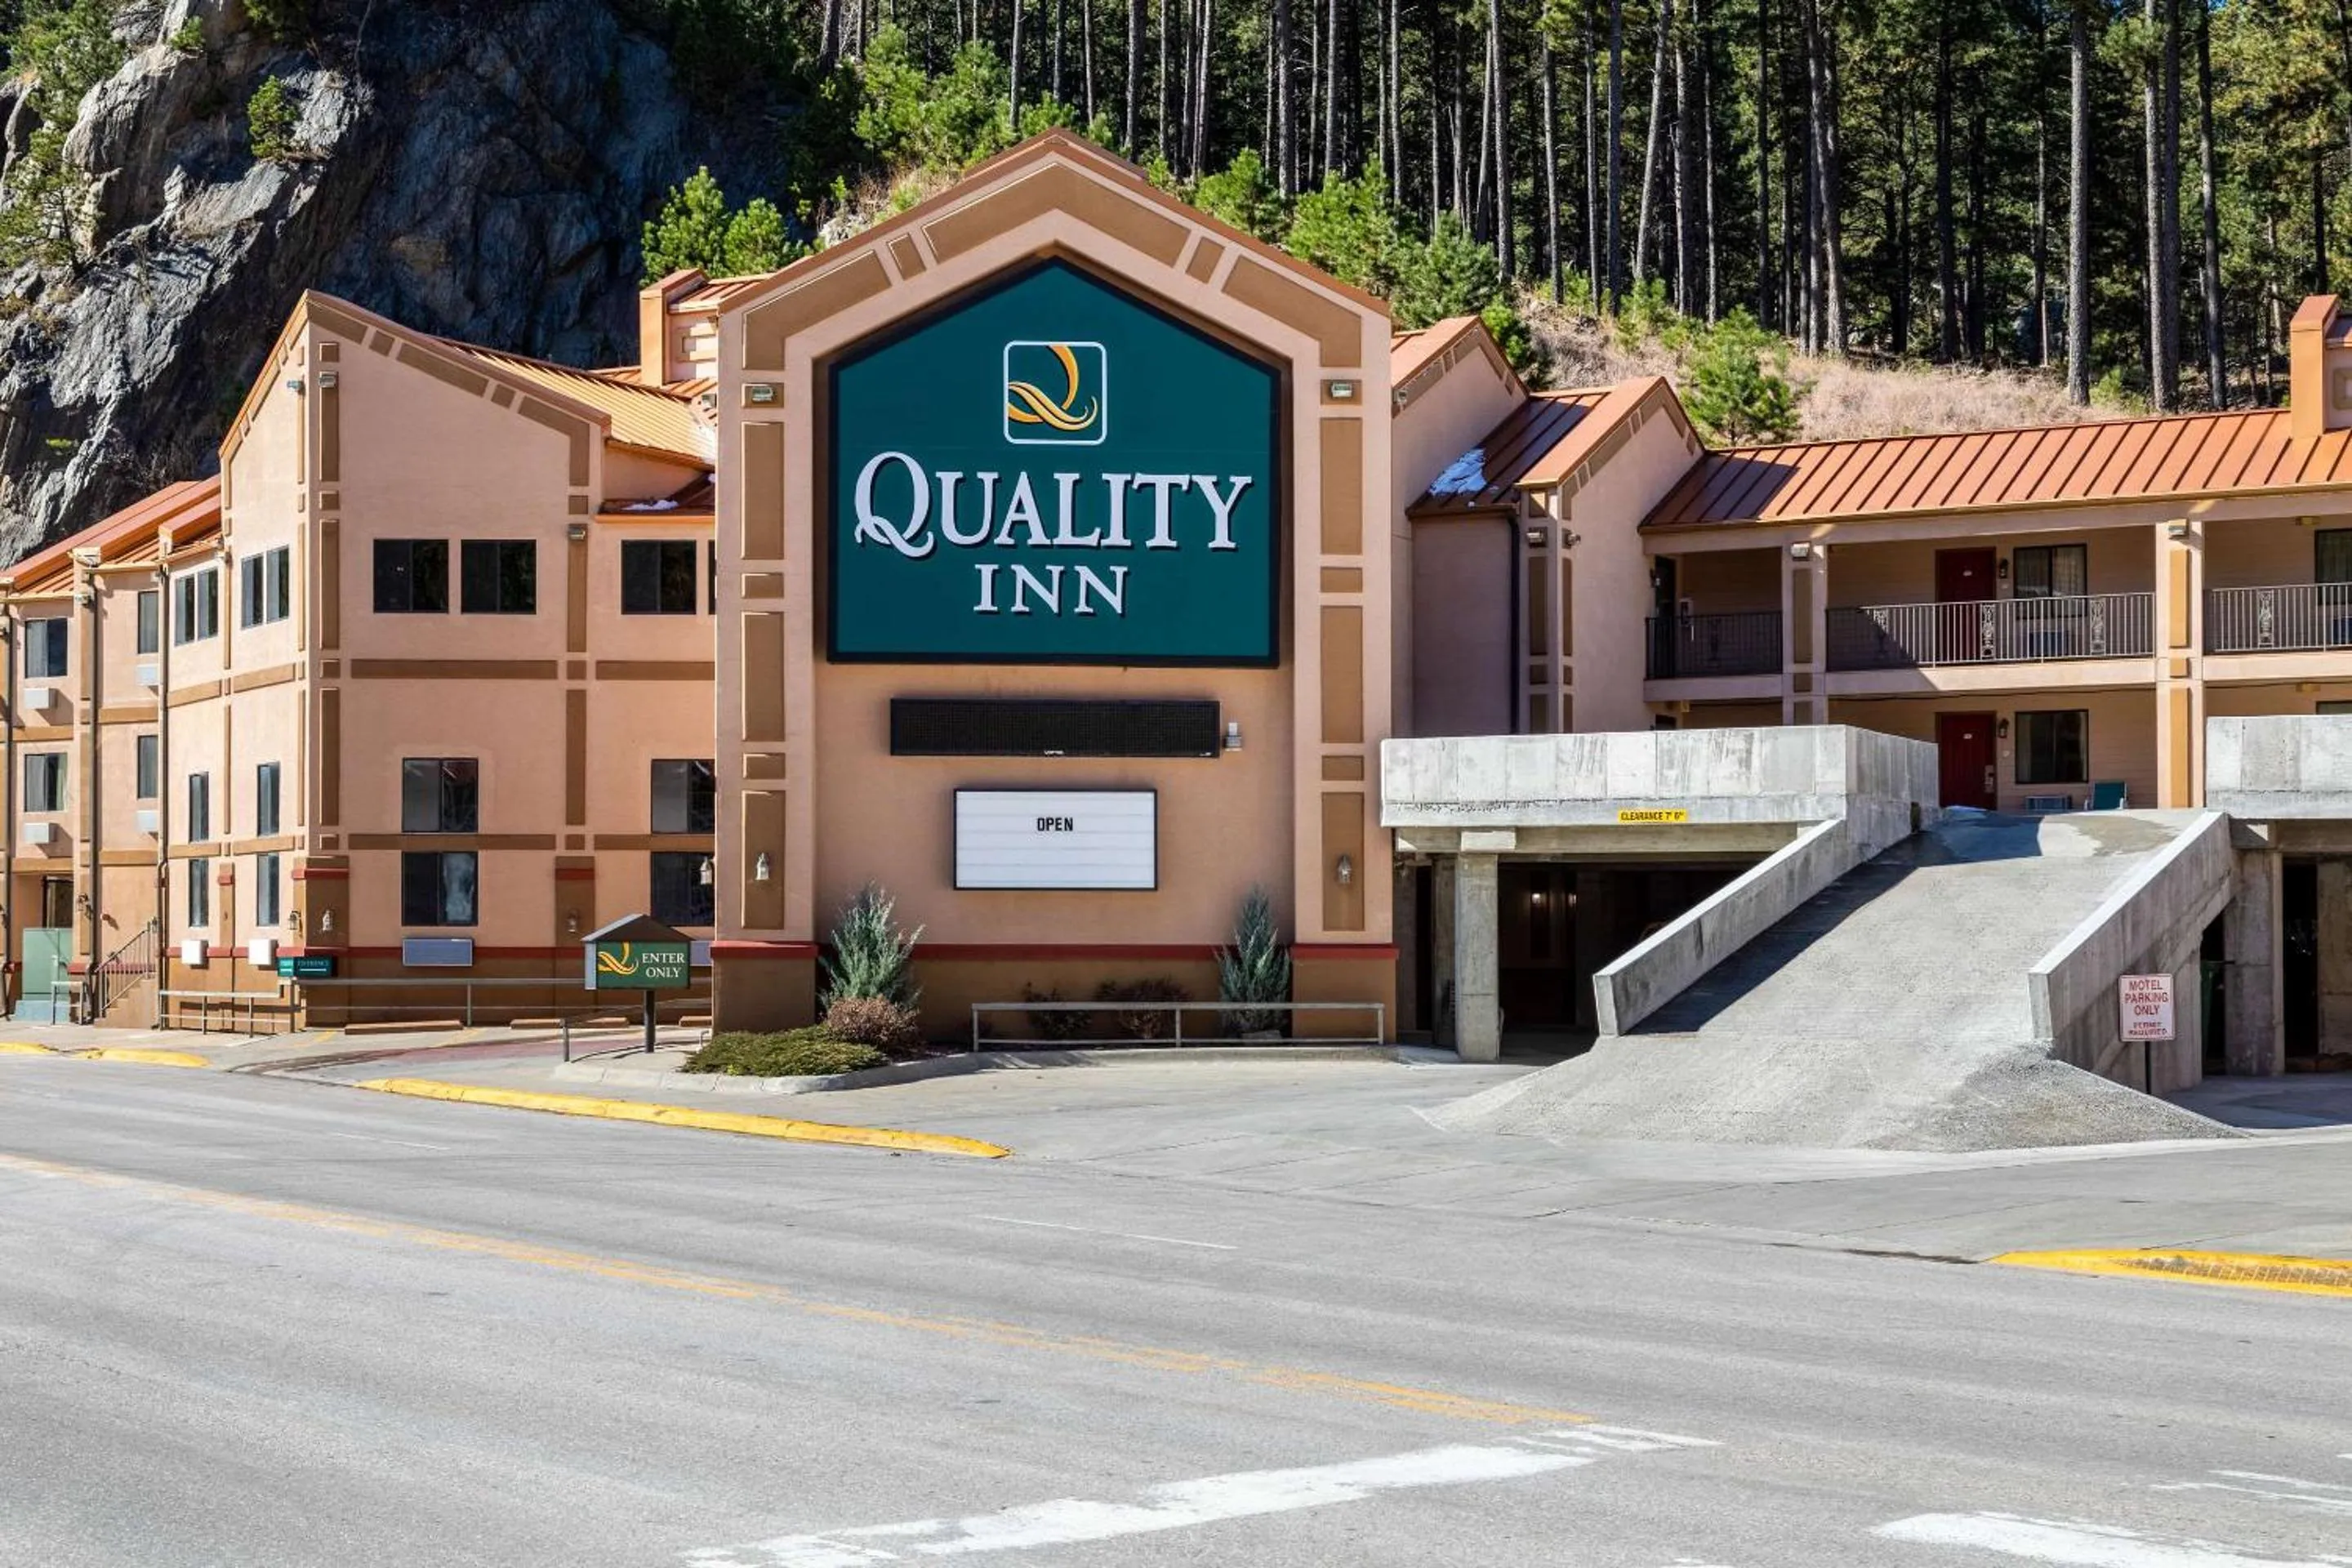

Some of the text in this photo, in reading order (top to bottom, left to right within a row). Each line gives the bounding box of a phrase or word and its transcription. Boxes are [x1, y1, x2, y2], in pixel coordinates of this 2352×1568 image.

[854, 451, 1252, 557] QUALITY
[973, 564, 1129, 614] INN
[1620, 811, 1664, 821] CLEARANCE
[1037, 817, 1073, 831] OPEN
[642, 952, 685, 964] ENTER
[645, 967, 682, 978] ONLY
[2129, 979, 2163, 991] MOTEL
[2124, 991, 2169, 1004] PARKING
[2133, 1004, 2161, 1015] ONLY
